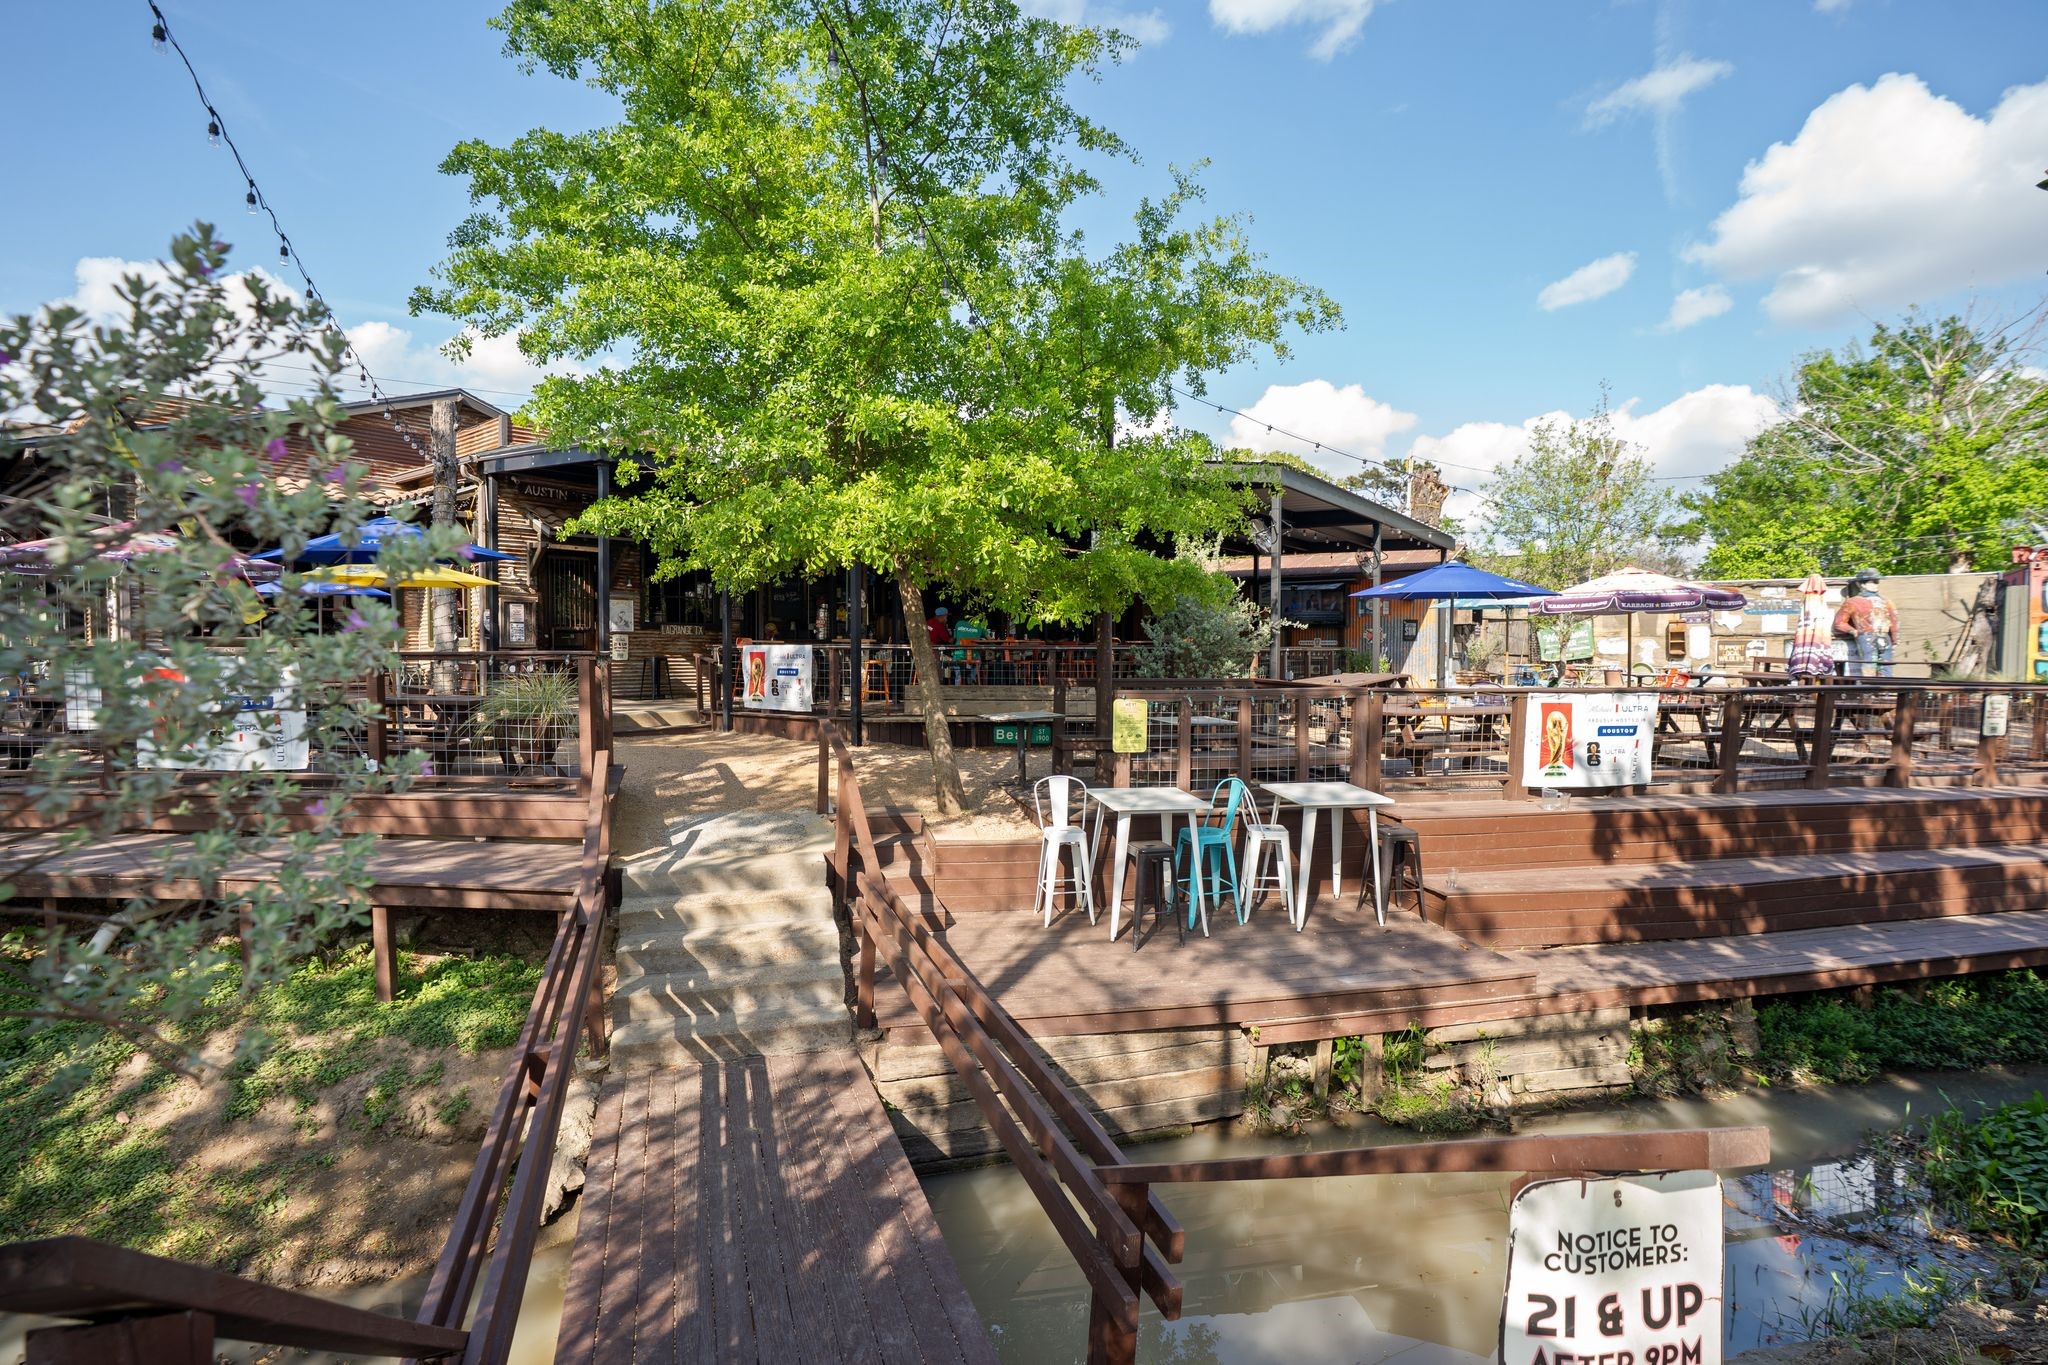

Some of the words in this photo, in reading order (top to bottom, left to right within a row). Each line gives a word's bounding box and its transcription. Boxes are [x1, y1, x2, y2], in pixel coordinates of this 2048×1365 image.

[524, 484, 568, 501] AUSTIN
[1660, 600, 1696, 608] BREWING
[694, 625, 704, 636] TX
[1621, 705, 1649, 713] ULTRA
[1557, 1227, 1641, 1255] NOTICE
[1650, 1224, 1679, 1246] TO
[1544, 1243, 1689, 1275] CUSTOMERS:
[1525, 1292, 1577, 1339] 21
[1597, 1291, 1624, 1338] &
[1641, 1281, 1704, 1332] UP
